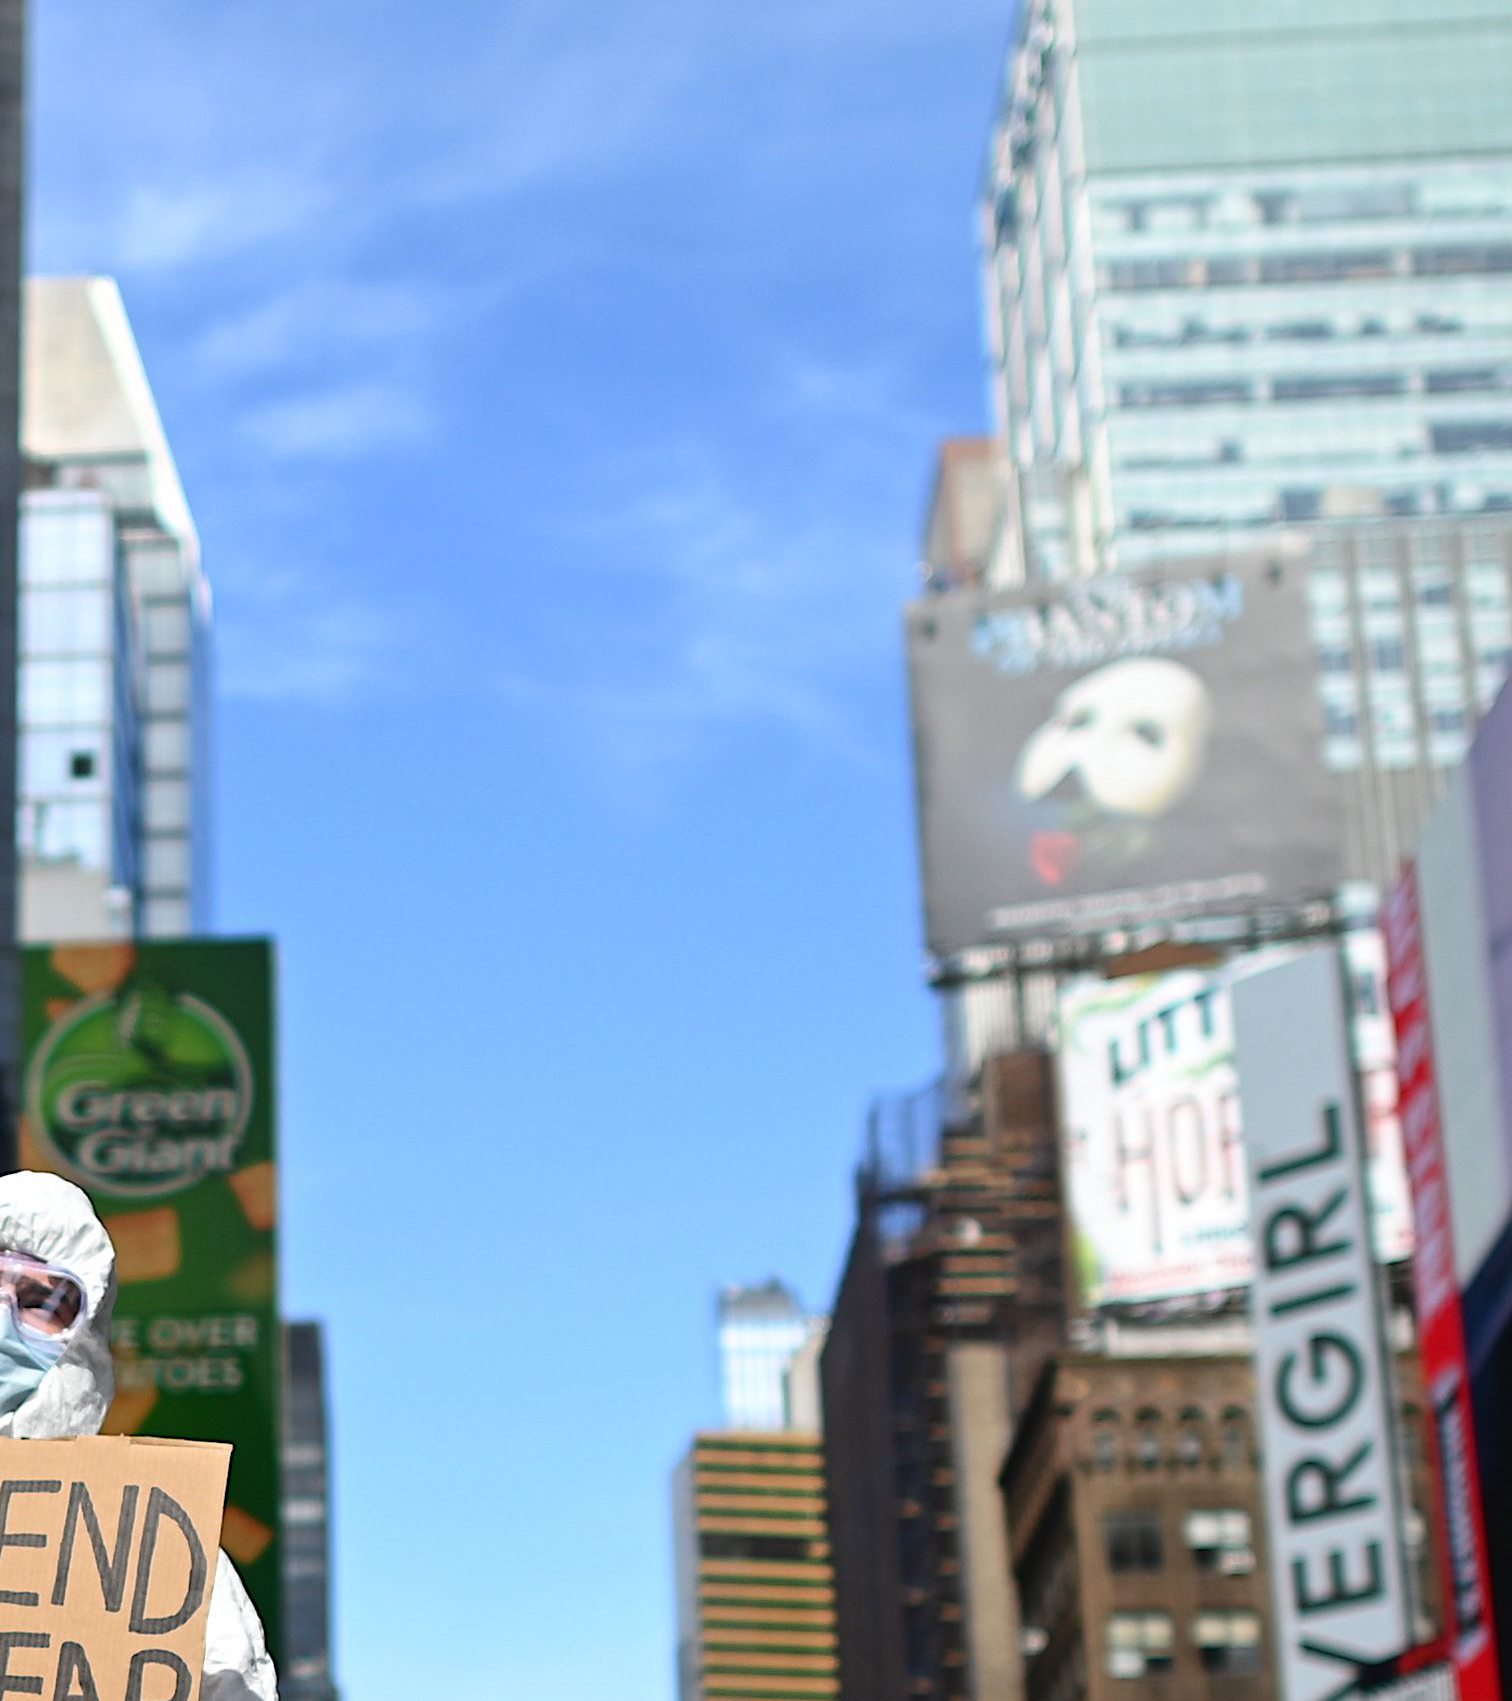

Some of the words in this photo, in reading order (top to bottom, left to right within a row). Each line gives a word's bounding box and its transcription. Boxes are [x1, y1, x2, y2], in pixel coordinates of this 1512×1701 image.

[1108, 983, 1226, 1086] LITT
[59, 1080, 238, 1130] Green
[78, 1127, 239, 1175] Giant
[147, 1315, 258, 1347] OVER
